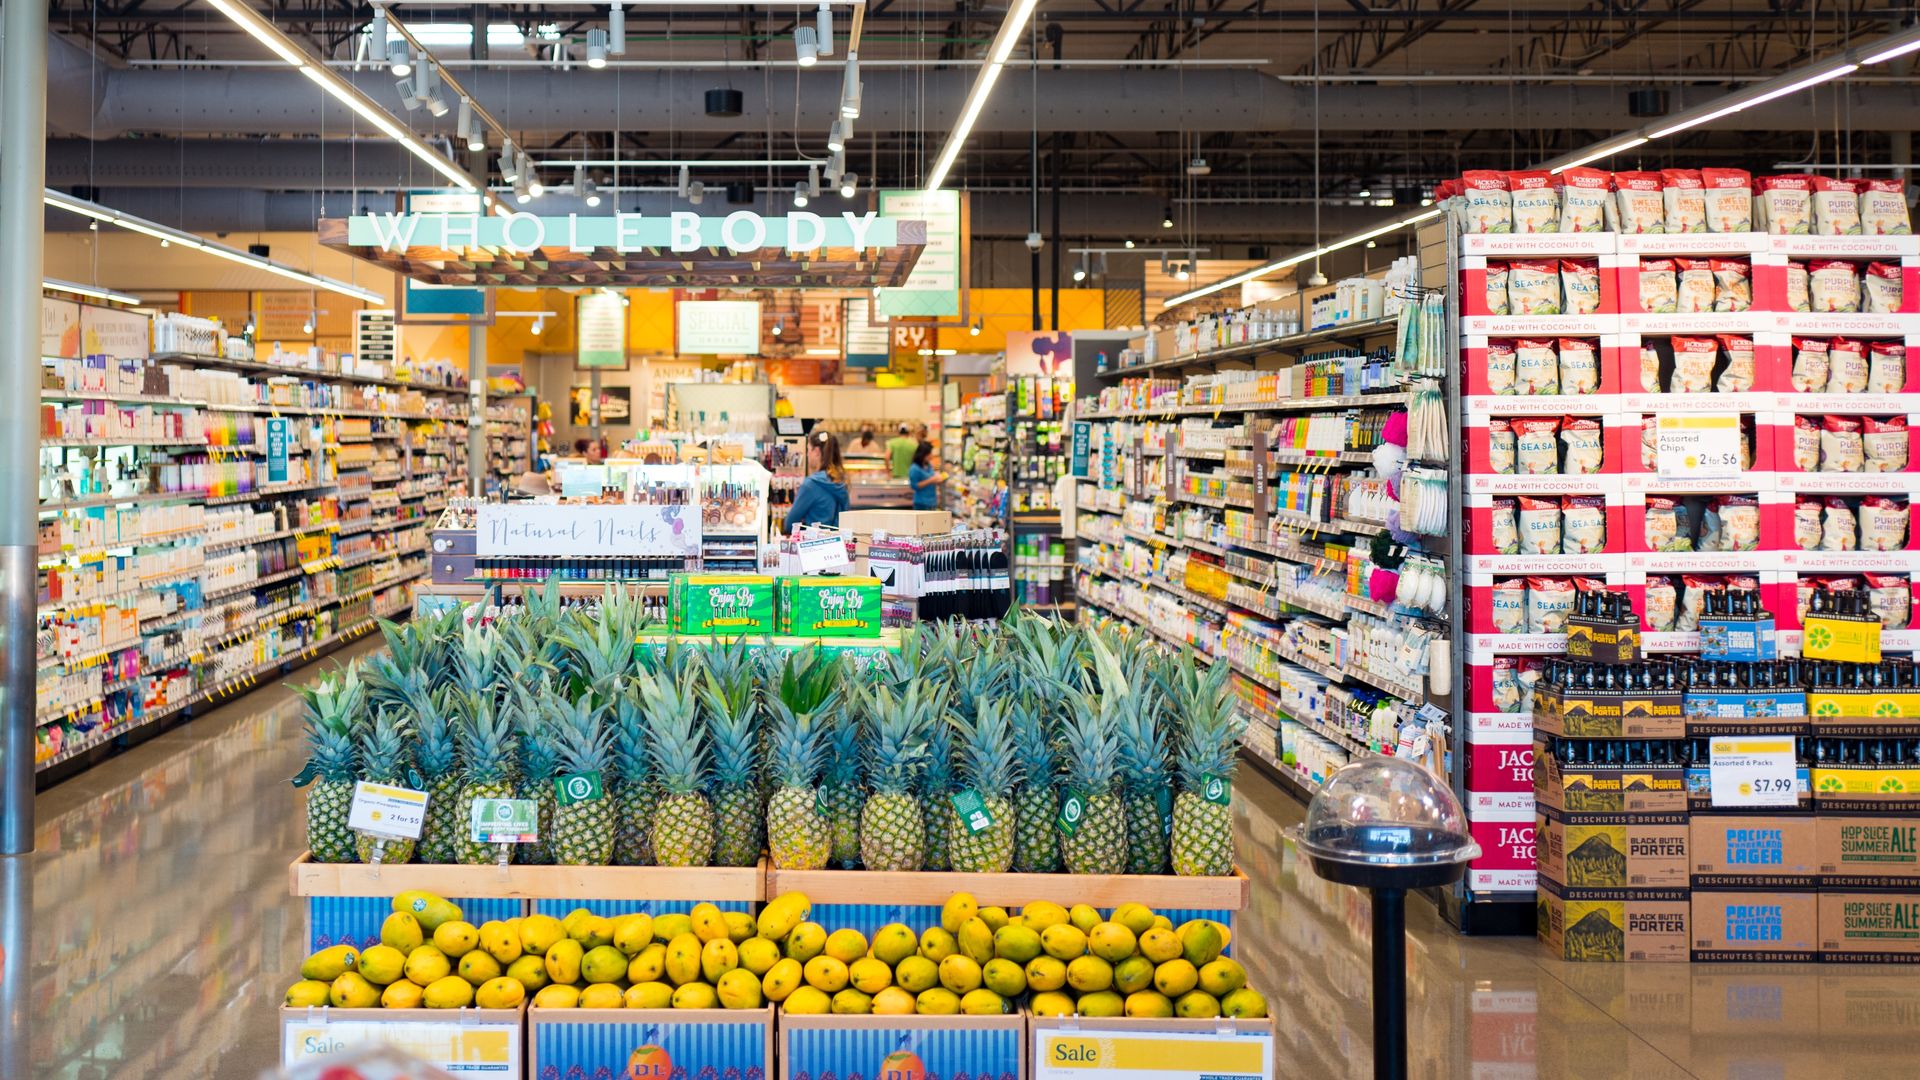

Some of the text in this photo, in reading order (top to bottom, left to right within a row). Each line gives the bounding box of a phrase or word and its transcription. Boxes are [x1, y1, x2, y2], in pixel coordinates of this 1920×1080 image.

[1474, 198, 1490, 206] SEA
[1536, 199, 1554, 207] SALT
[689, 311, 750, 330] SPECIAL
[653, 368, 694, 379] ANIMA
[1660, 435, 1699, 443] Assorted
[1521, 443, 1540, 451] SEA
[1660, 444, 1685, 453] Chips
[1700, 453, 1737, 465] 2 for $6
[488, 517, 661, 546] Natural Nails
[1531, 521, 1548, 530] SEA
[708, 586, 755, 609] Enjoy By
[819, 588, 864, 611] Enjoy By
[1537, 601, 1555, 609] SEA
[1524, 642, 1544, 650] WITH
[1693, 726, 1748, 734] DESCHUTES
[1754, 779, 1791, 792] $7.99
[396, 815, 408, 823] for
[409, 817, 419, 825] $5
[1726, 829, 1782, 841] PACIFIC
[1841, 826, 1863, 840] HOP
[1841, 827, 1917, 853] SUMMER ALE
[1631, 845, 1685, 856] PORTER
[1726, 848, 1783, 864] LAGER
[1726, 905, 1782, 917] PACIFIC
[1844, 902, 1865, 916] HOP
[1844, 903, 1919, 929] SUMMER ALE
[1629, 921, 1684, 932] PORTER
[1726, 925, 1782, 940] LAGER
[305, 1037, 345, 1054] Sale
[1055, 1043, 1097, 1062] Sale
